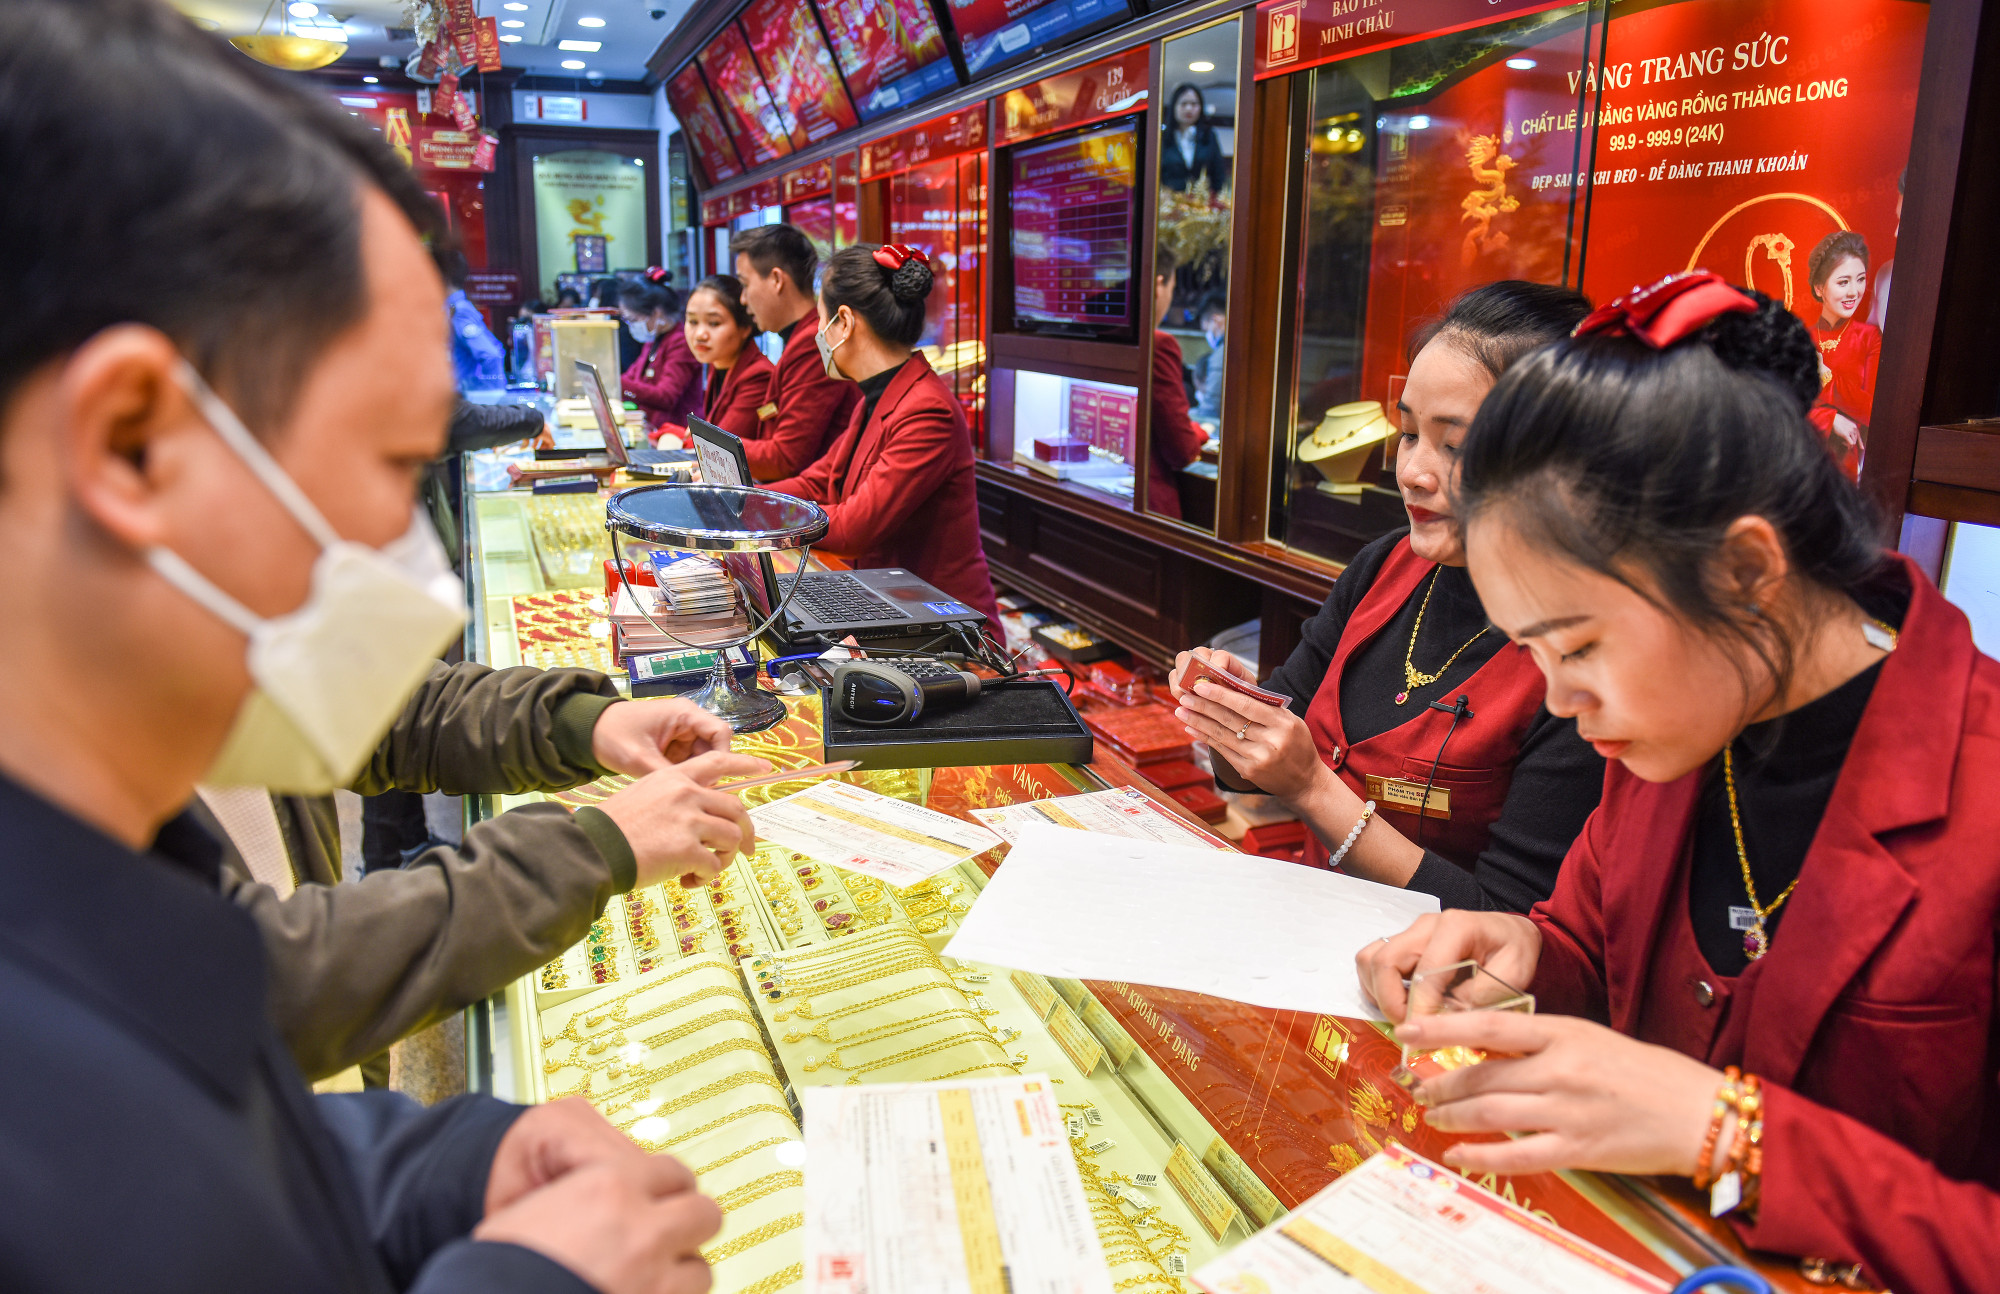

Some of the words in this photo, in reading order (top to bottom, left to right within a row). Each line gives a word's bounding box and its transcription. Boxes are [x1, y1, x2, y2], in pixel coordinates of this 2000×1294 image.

[1320, 21, 1355, 46] MINH
[1356, 9, 1395, 36] CHÂU
[1107, 66, 1124, 87] 139
[1566, 61, 1633, 95] VÀNG
[1640, 46, 1725, 85] TRANG
[1732, 31, 1789, 71] SỨC
[1521, 110, 1556, 136] CHẤT
[1637, 99, 1678, 122] VÀNG
[1681, 89, 1728, 116] RỒNG
[1731, 83, 1792, 110] THĂNG
[1795, 77, 1849, 103] LONG
[1609, 133, 1636, 151] 99.9
[1646, 128, 1683, 148] 999.9
[1685, 122, 1724, 147] (24K)
[1531, 174, 1553, 192] ĐẸP
[1613, 168, 1638, 184] ĐEO
[1648, 159, 1666, 182] DỄ
[1668, 160, 1704, 179] DÀNG
[1707, 158, 1754, 177] THANH
[1755, 150, 1809, 174] KHOẢN
[1012, 764, 1043, 801] VÀNG
[1387, 786, 1405, 794] PHẠM
[1127, 989, 1160, 1030] KHOẢN
[1157, 1021, 1177, 1044] DỄ
[1171, 1035, 1201, 1072] DÀNG
